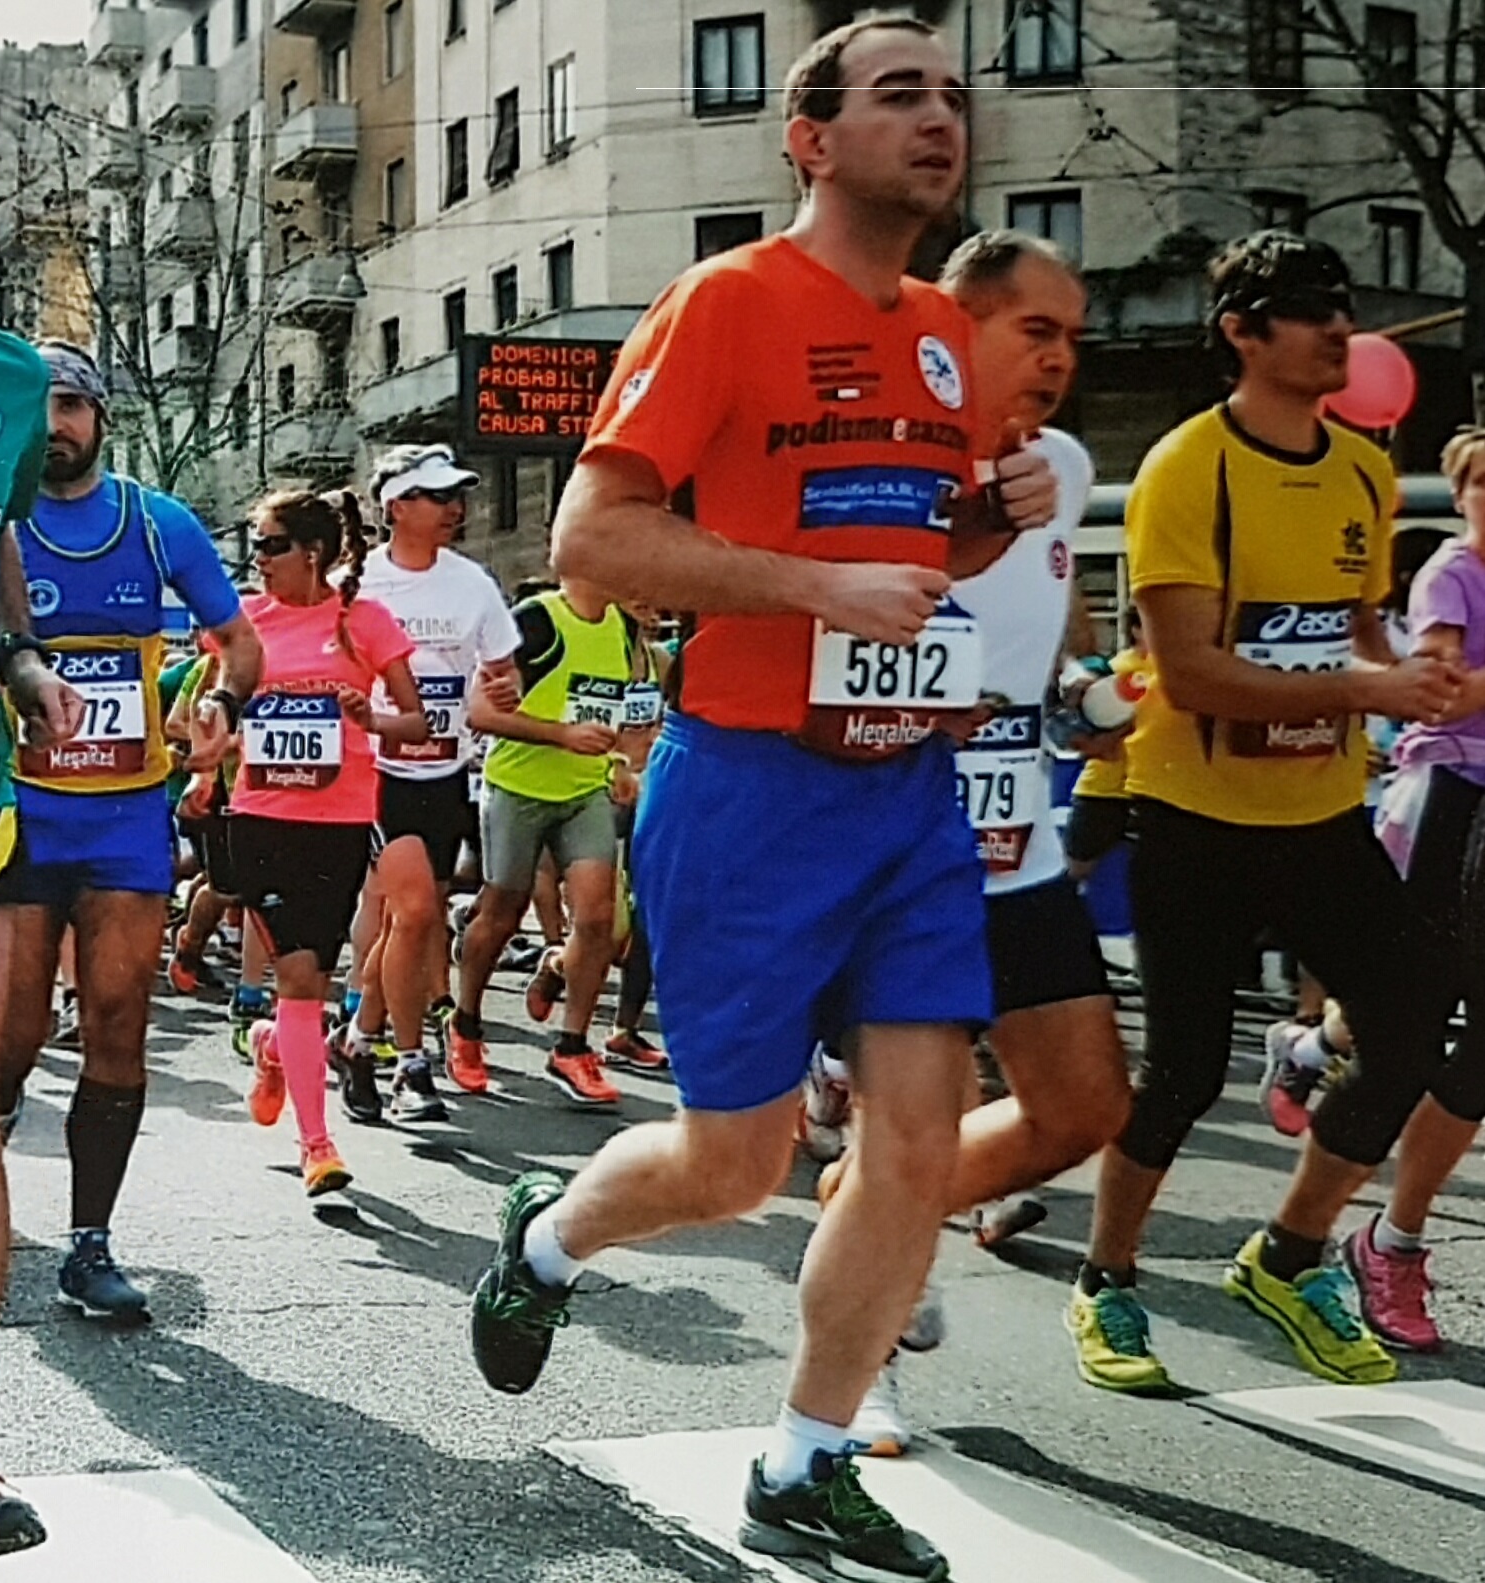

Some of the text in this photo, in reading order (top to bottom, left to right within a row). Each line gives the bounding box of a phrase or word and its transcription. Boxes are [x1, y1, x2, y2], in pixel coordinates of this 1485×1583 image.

[491, 344, 597, 365] DOMENICA
[478, 366, 595, 390] PROBABILI
[478, 391, 594, 412] AL TRAFFI
[478, 413, 546, 434] CAUSA
[844, 641, 948, 699] 5812
[84, 697, 123, 737] 72
[261, 730, 323, 761] 4706
